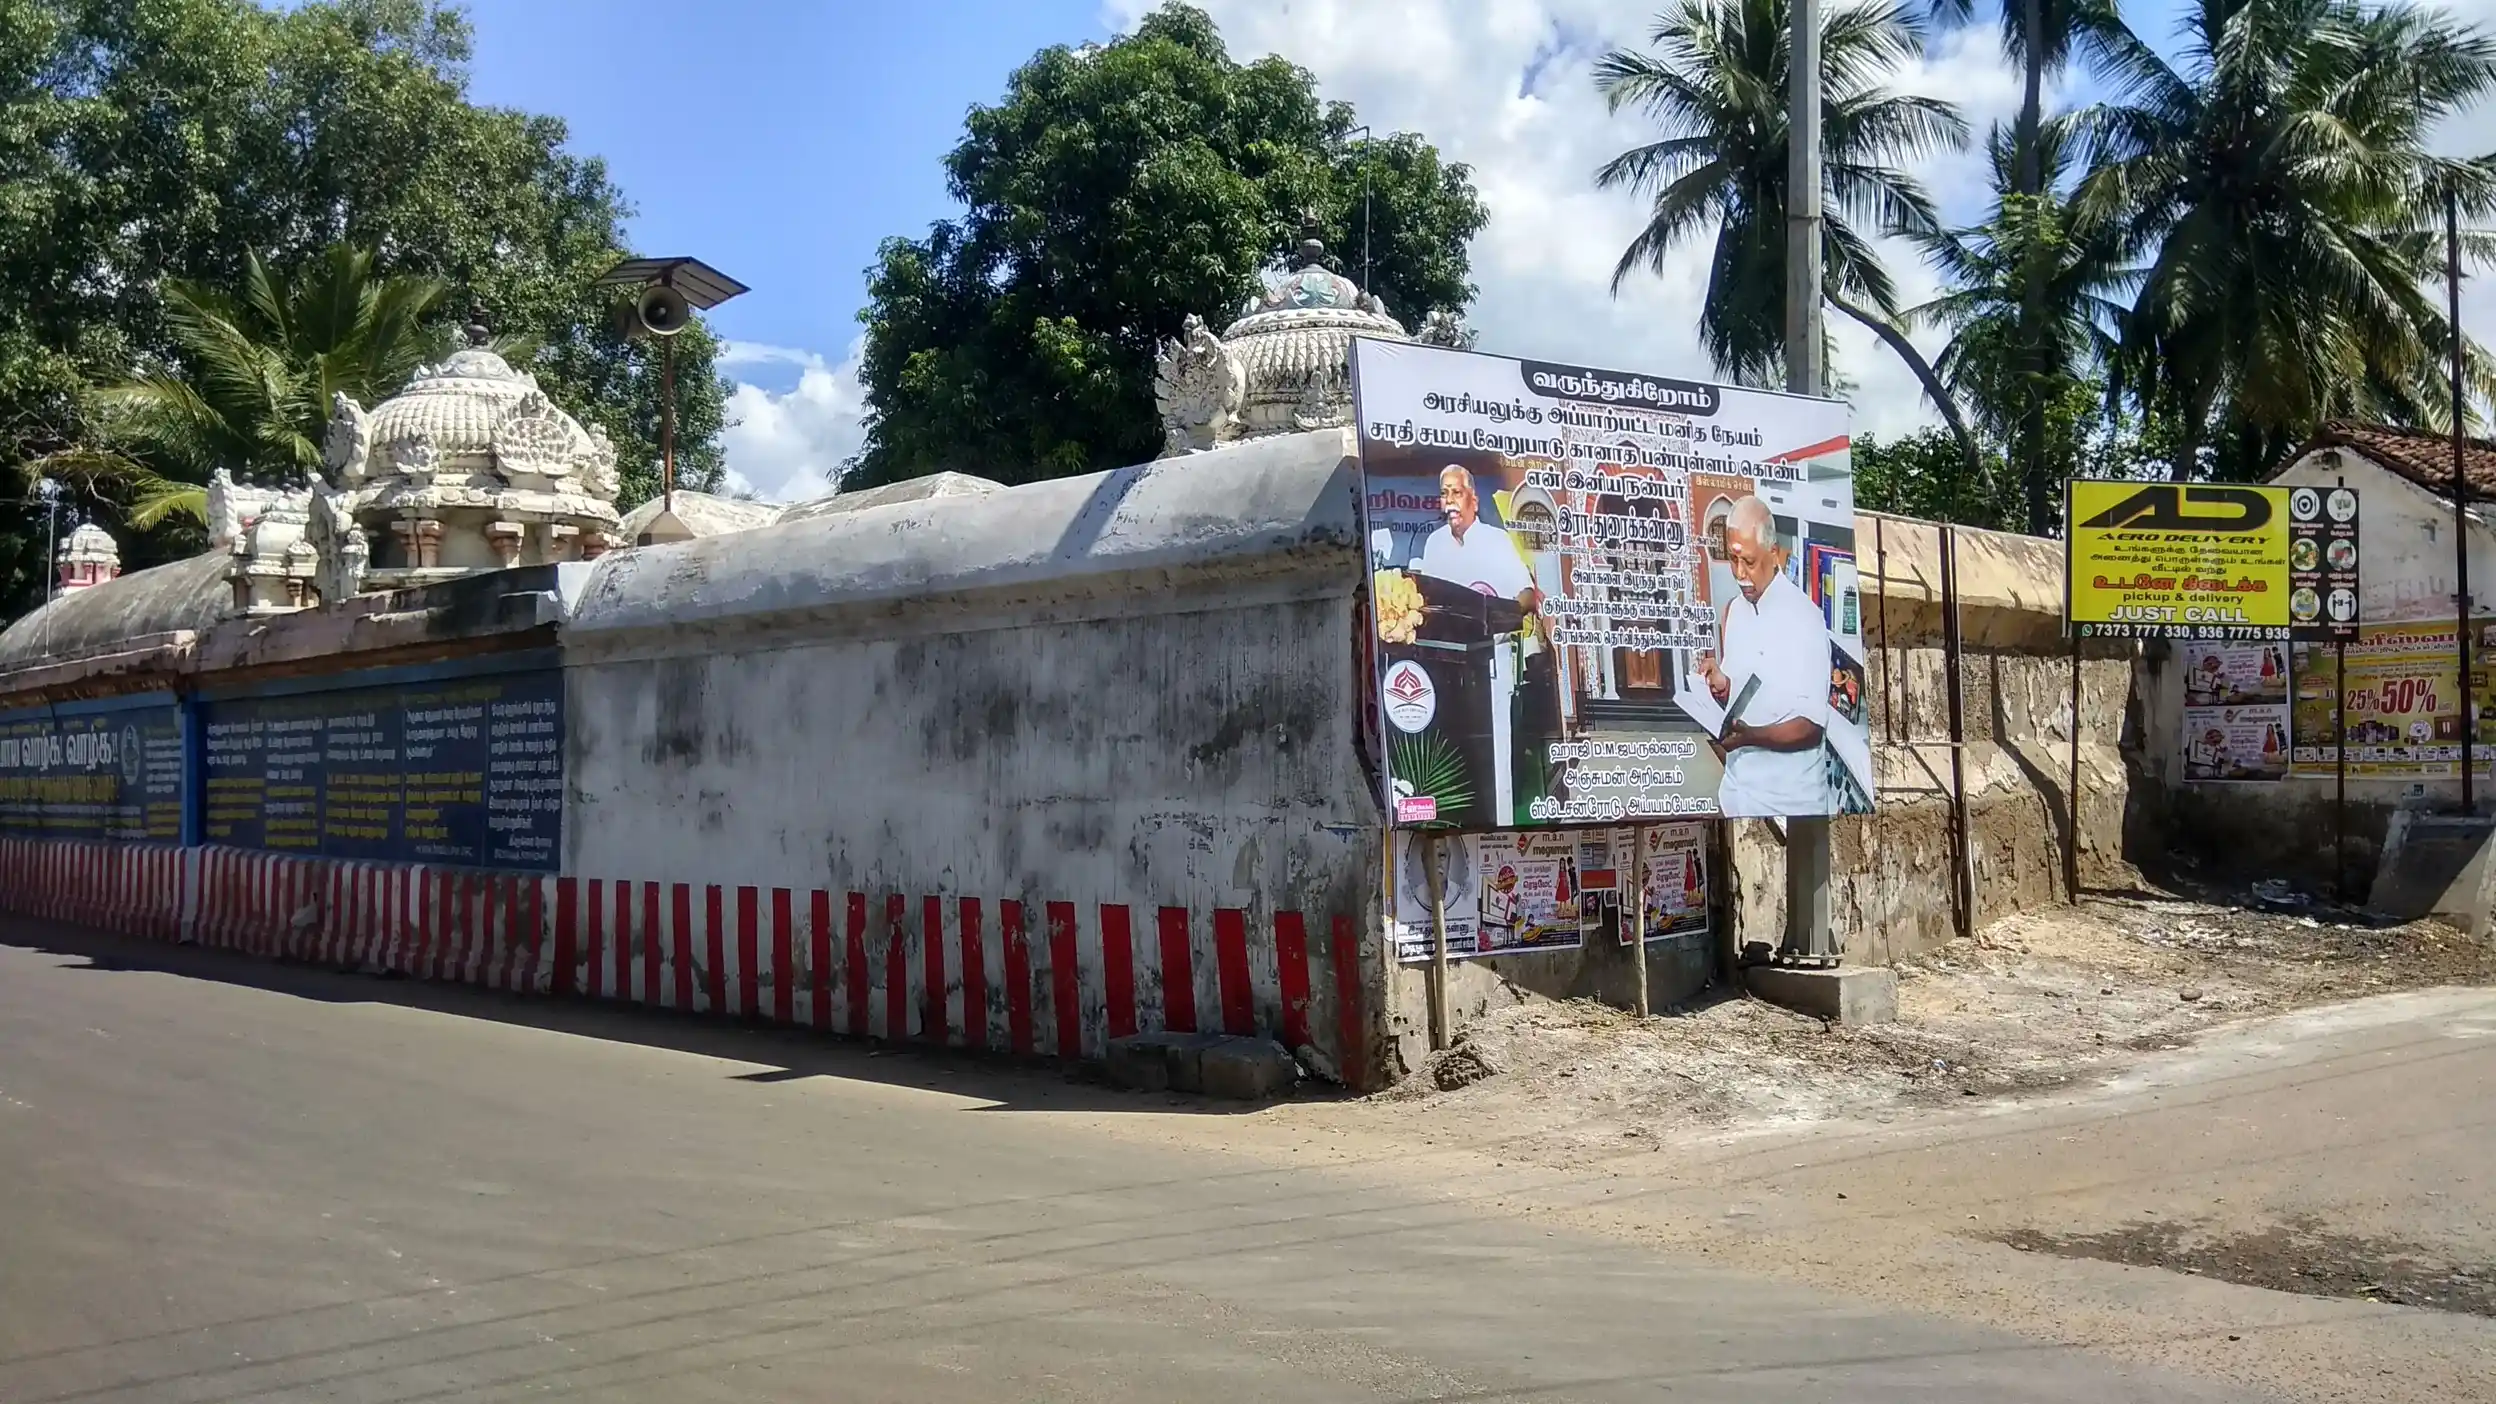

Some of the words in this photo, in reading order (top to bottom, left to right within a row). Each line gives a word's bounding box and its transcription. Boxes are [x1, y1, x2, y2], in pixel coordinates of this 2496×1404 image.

[1533, 371, 1712, 408] வருந்துகிறோம்
[1424, 392, 1542, 424] அரசியலுக்கு
[1549, 404, 1655, 433] அப்பாற்பட்ட
[1659, 419, 1706, 443] மனித
[1711, 425, 1763, 447] நேயம்
[1370, 420, 1413, 447] சாதி
[1419, 427, 1467, 446] சமய
[1473, 428, 1564, 457] வேறுபாடு
[1642, 446, 1736, 476] பண்புள்ளம்
[1740, 457, 1806, 481] கொண்ட
[1525, 466, 1562, 488] என்
[1567, 469, 1624, 492] இனிய
[1624, 477, 1686, 500] நண்பர்
[1558, 506, 1685, 551] இரா.துரைக்கண்ணு
[2097, 533, 2160, 542] AERO
[2164, 534, 2273, 544] DELIVERY
[2113, 545, 2187, 555] உங்களுக்கு
[2190, 545, 2264, 556] தேவையான
[2240, 557, 2286, 566] உங்கள்
[1572, 569, 1621, 586] அவர்களை
[1624, 570, 1656, 592] இழந்து
[1657, 572, 1687, 591] வாடும்
[2152, 564, 2191, 574] வீட்டில்
[2195, 565, 2227, 575] வந்து
[2093, 573, 2176, 590] உடனே
[2182, 575, 2267, 592] கிடைக்க
[2123, 592, 2170, 603] pickup
[2175, 593, 2184, 602] &
[2189, 593, 2244, 604] delivery
[1682, 601, 1715, 624] ஆழ்ந்த
[2108, 605, 2177, 622] JUST
[2184, 606, 2250, 623] CALL
[1553, 627, 1602, 646] இரங்கலை
[2096, 624, 2130, 637] 7373
[2134, 624, 2159, 638] 777
[2164, 625, 2195, 640] 330,
[2198, 625, 2224, 639] 936
[2228, 625, 2263, 639] 7775
[2266, 626, 2290, 640] 936
[2346, 688, 2379, 711] 25%
[2381, 678, 2437, 714] 50%
[1551, 741, 1590, 762] ஹாஜி
[1564, 766, 1626, 790] அஞ்சுமன்
[1628, 766, 1683, 791] அறிவகம்
[1530, 794, 1624, 820] ஸ்டேசன்ரோடு,
[1628, 793, 1718, 816] அய்யம்பேட்டை
